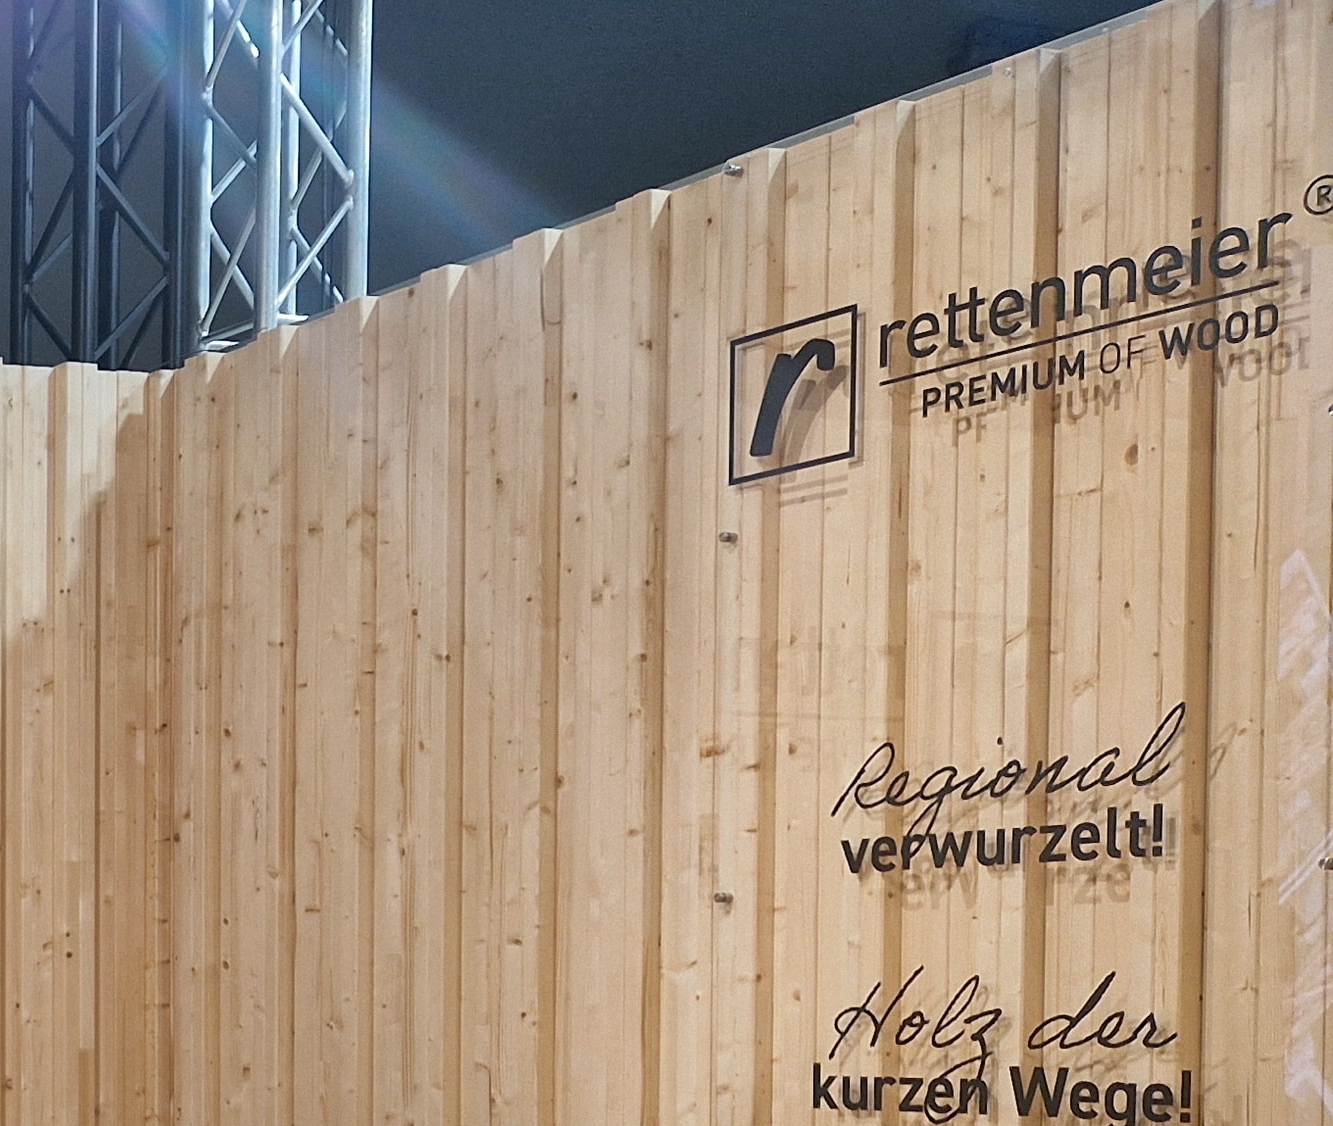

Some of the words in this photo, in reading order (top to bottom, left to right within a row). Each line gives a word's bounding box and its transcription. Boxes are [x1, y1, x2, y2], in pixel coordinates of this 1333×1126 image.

[921, 355, 1086, 418] PREMIUM
[1098, 334, 1148, 375] OF
[1159, 302, 1280, 361] WOOD
[831, 702, 1187, 860] Regional
[841, 803, 1165, 875] verwurzelt!
[812, 1062, 989, 1116] kurzen
[829, 965, 1003, 1124] Holz
[1027, 970, 1179, 1050] der
